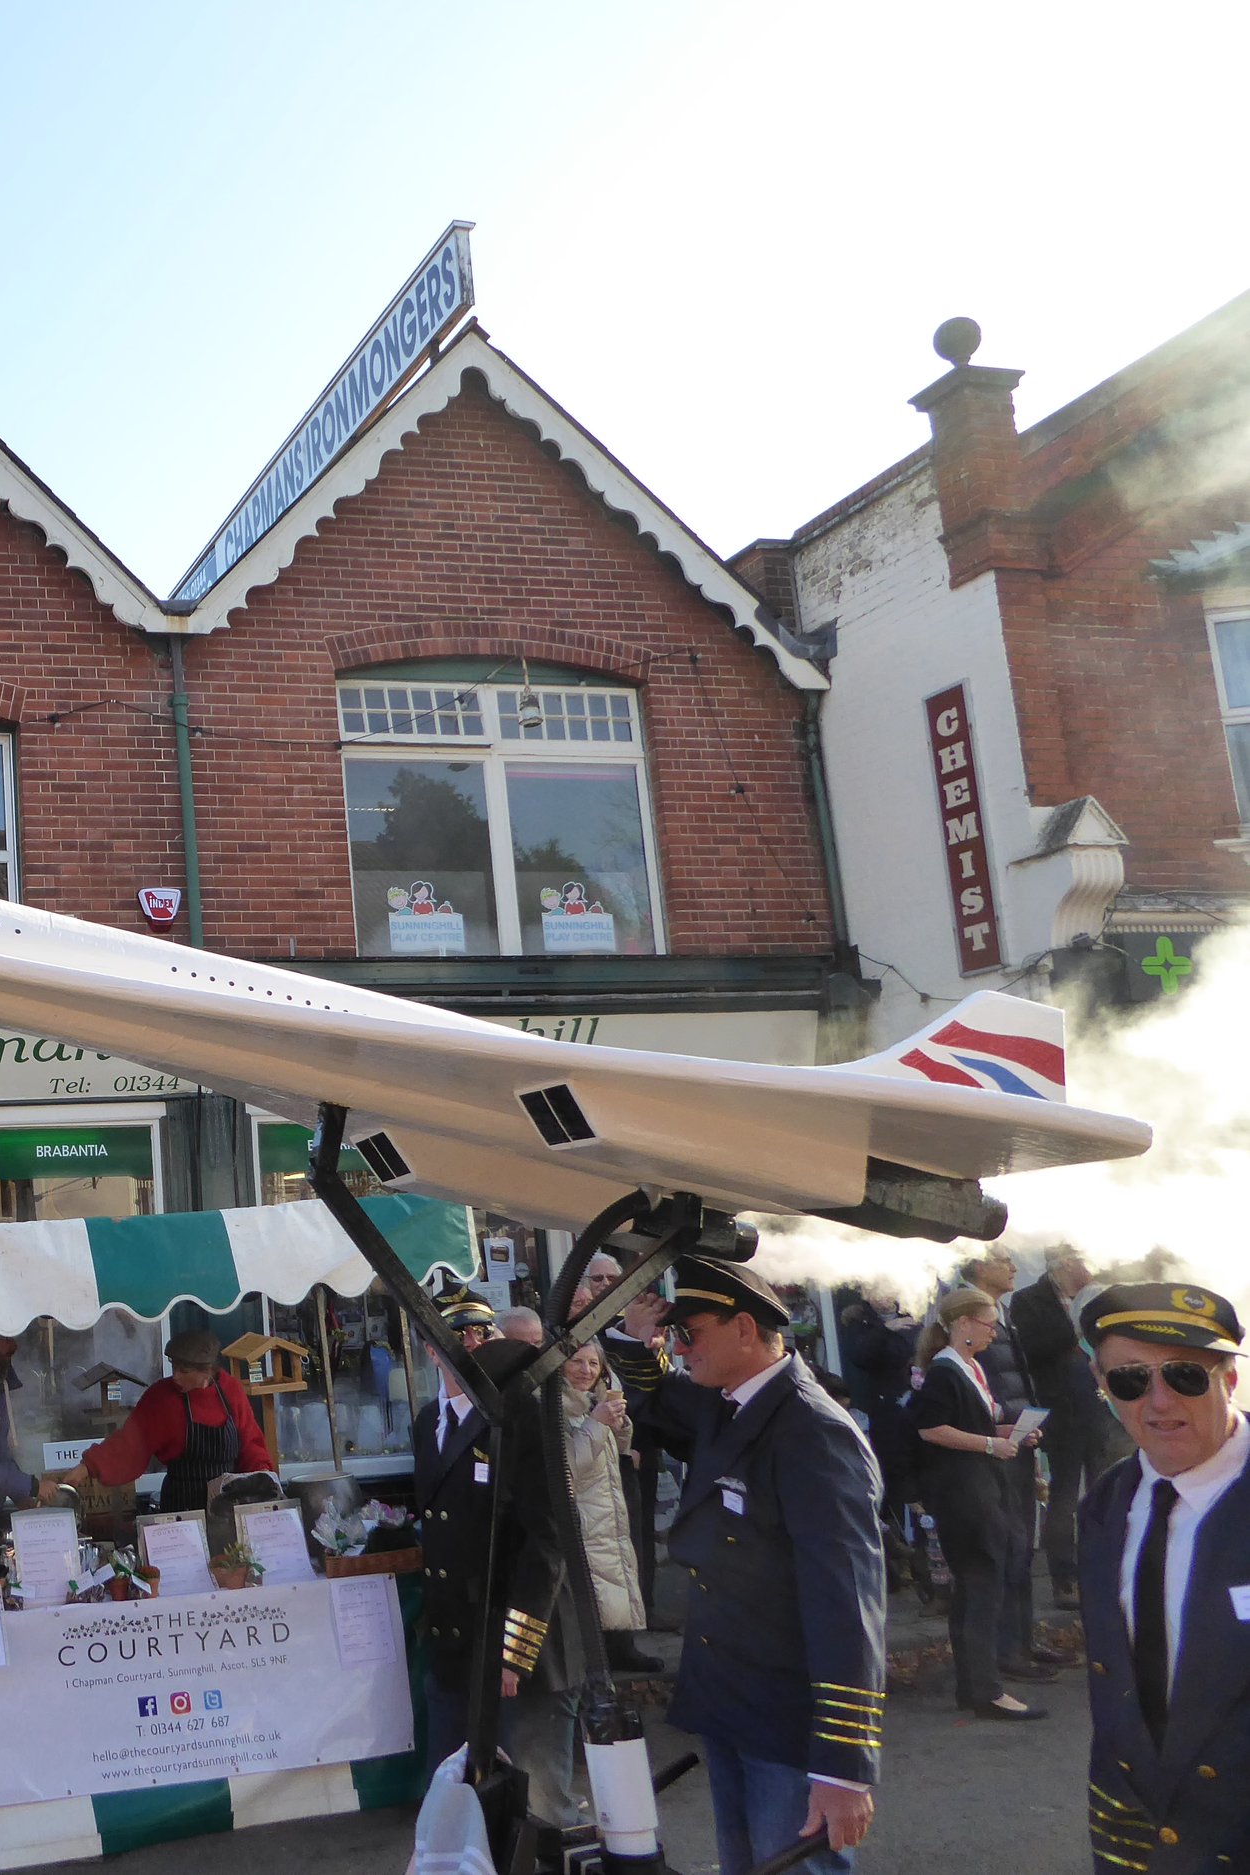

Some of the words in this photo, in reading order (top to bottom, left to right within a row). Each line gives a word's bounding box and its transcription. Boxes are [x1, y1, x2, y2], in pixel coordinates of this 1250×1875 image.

[223, 440, 304, 569] CHAPMANS
[303, 246, 456, 479] IRONMONGERS
[936, 706, 990, 951] CHEMIST
[390, 920, 462, 931] SUNNINGHILL
[543, 920, 613, 931] SUNNINGHILL
[391, 932, 419, 942] PLAY
[420, 932, 463, 942] CENTRE
[546, 932, 571, 942] PLAY
[573, 932, 613, 942] CENTRE
[49, 1076, 91, 1094] Tel:
[113, 1075, 180, 1092] 01344
[35, 1143, 109, 1159] BRABANTIA
[55, 1449, 79, 1461] THE
[152, 1610, 196, 1630] THE
[57, 1622, 291, 1667] COURTYARD
[71, 1676, 114, 1689] Chapman
[116, 1669, 166, 1684] Courtyard,
[167, 1663, 217, 1679] Sunninghill,
[220, 1660, 248, 1672] Ascot,
[250, 1657, 267, 1668] SL5
[269, 1654, 288, 1666] 9NF
[150, 1720, 182, 1736] 01344
[186, 1718, 205, 1731] 627
[210, 1715, 230, 1729] 687
